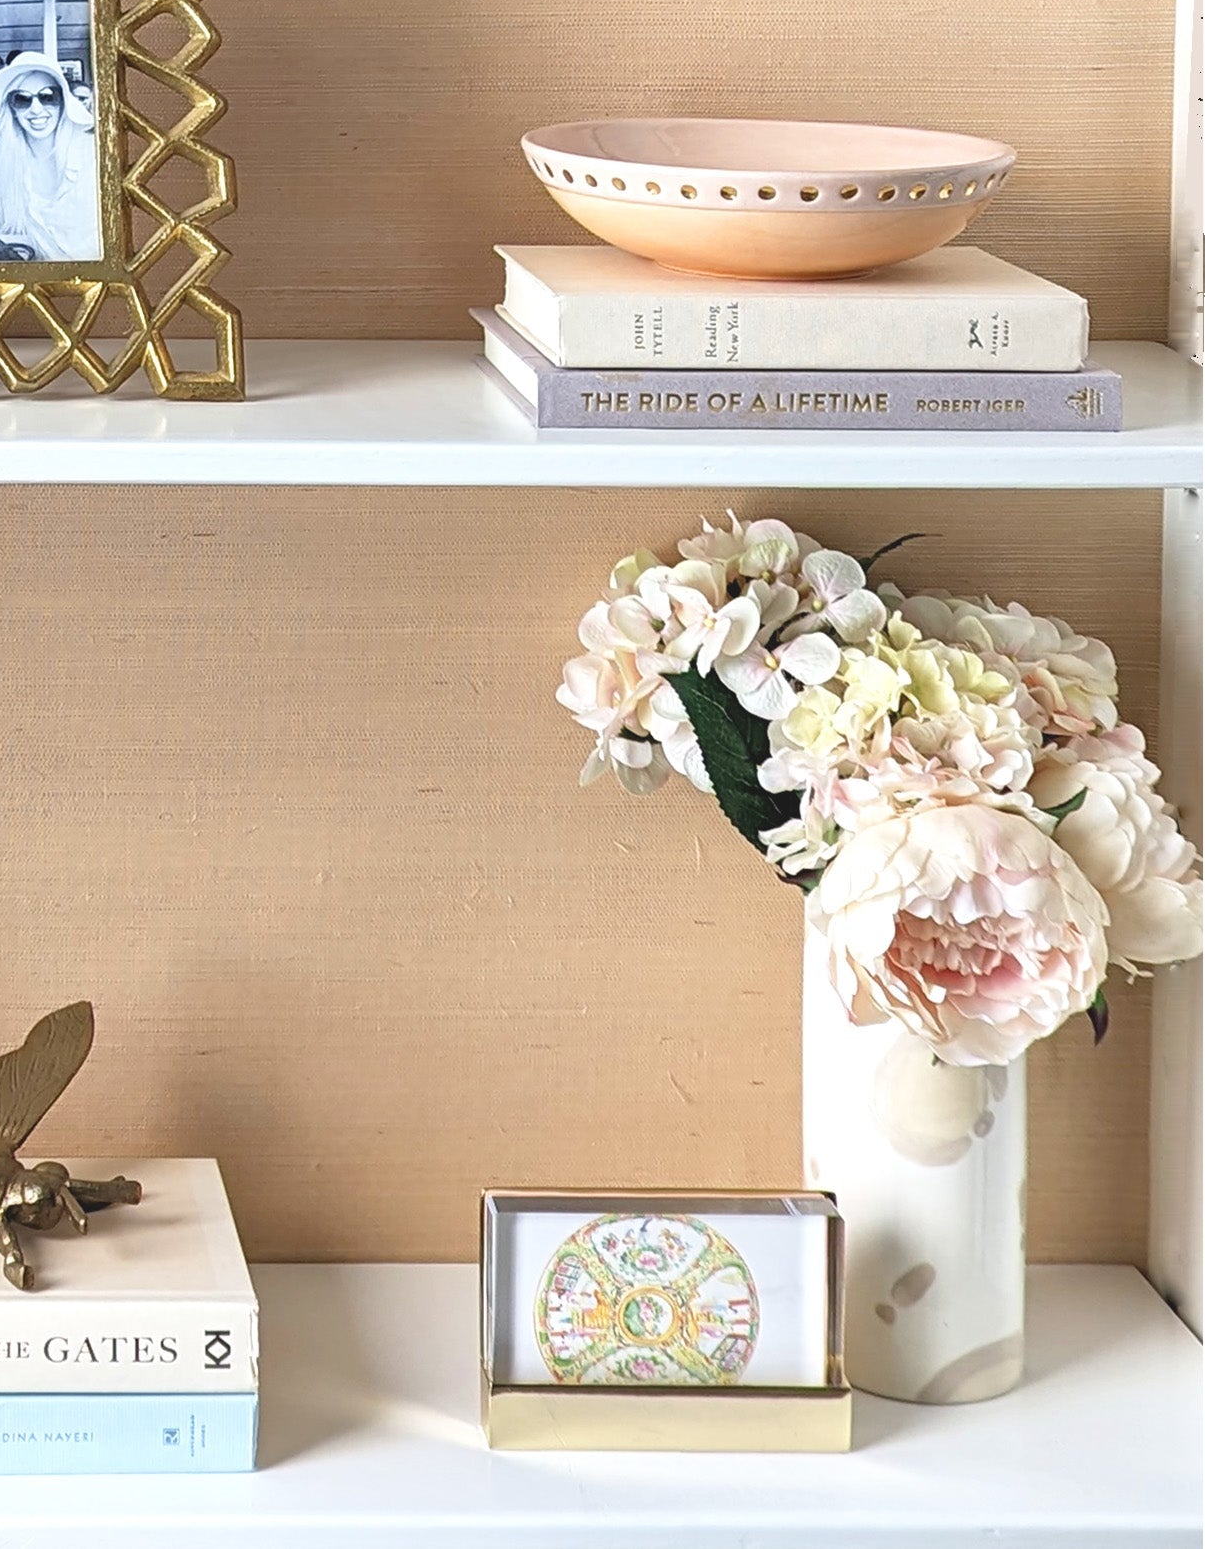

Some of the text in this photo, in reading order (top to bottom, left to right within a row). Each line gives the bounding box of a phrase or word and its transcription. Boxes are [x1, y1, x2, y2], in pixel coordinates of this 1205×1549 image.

[634, 313, 646, 350] JOHN
[652, 306, 664, 357] TYTELL
[704, 305, 721, 358] Reading
[726, 301, 740, 363] New York
[579, 392, 888, 414] THE RIDE OF A LIFETIME
[916, 399, 1025, 414] ROBERT IGER
[43, 1336, 178, 1363] GATES
[1, 1431, 94, 1444] DINA NAYERI
